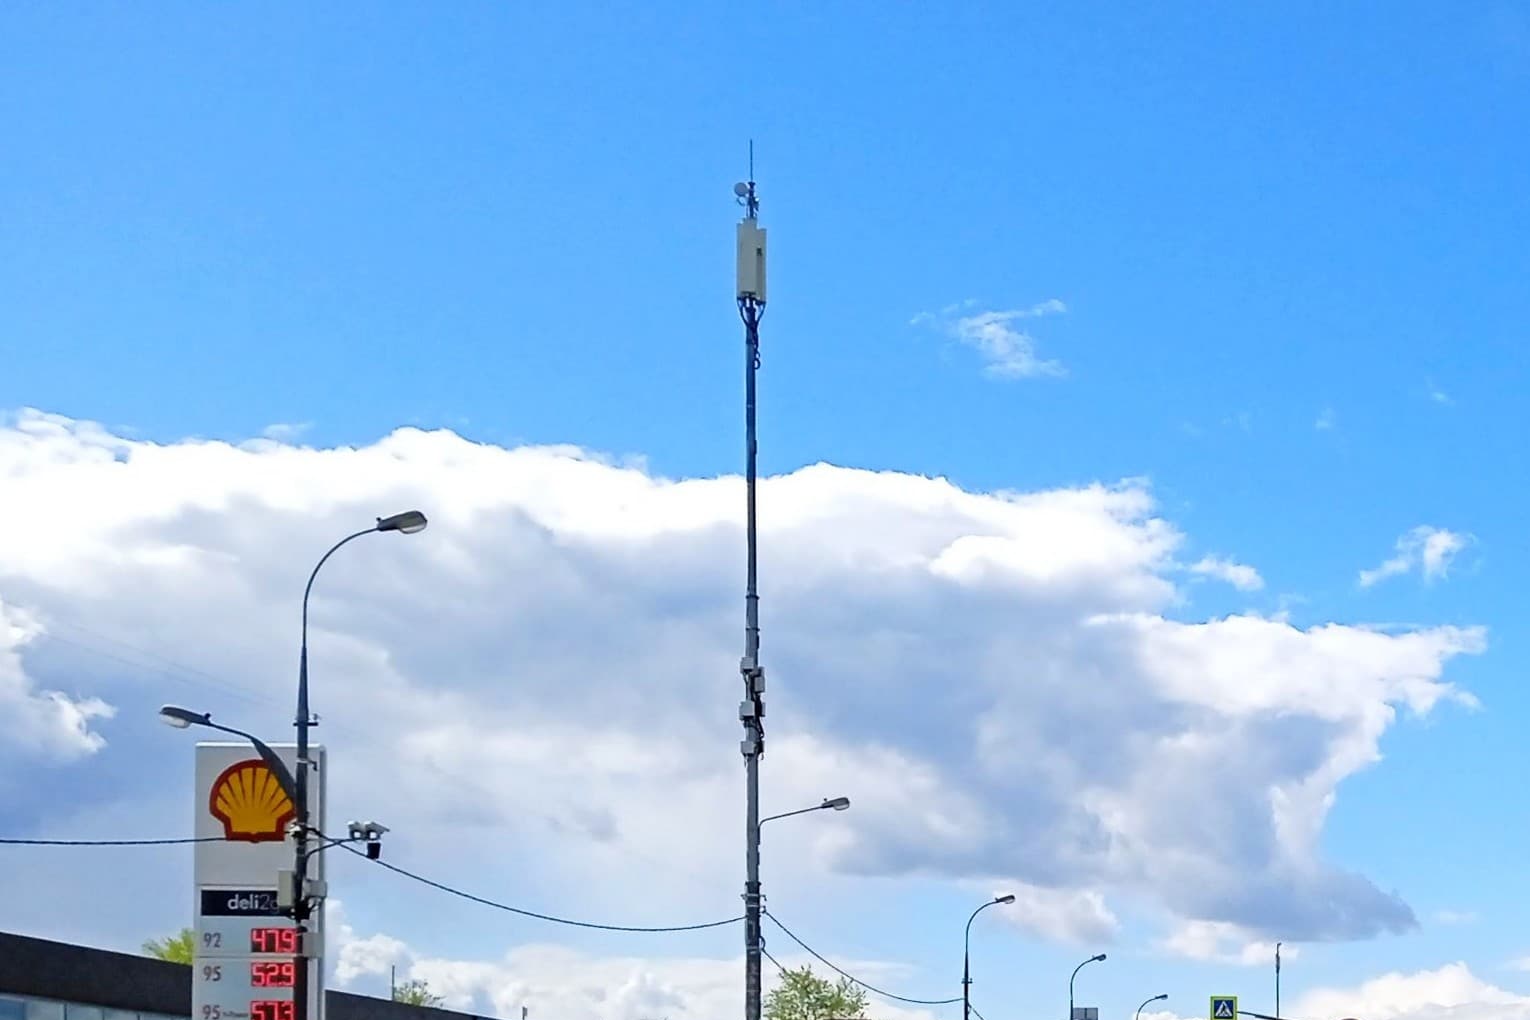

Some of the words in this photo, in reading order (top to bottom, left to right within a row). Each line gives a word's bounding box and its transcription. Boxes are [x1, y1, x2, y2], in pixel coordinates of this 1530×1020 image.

[227, 894, 280, 914] deli2g
[204, 932, 222, 948] 92
[204, 966, 222, 982] 95
[202, 1004, 221, 1020] 95
